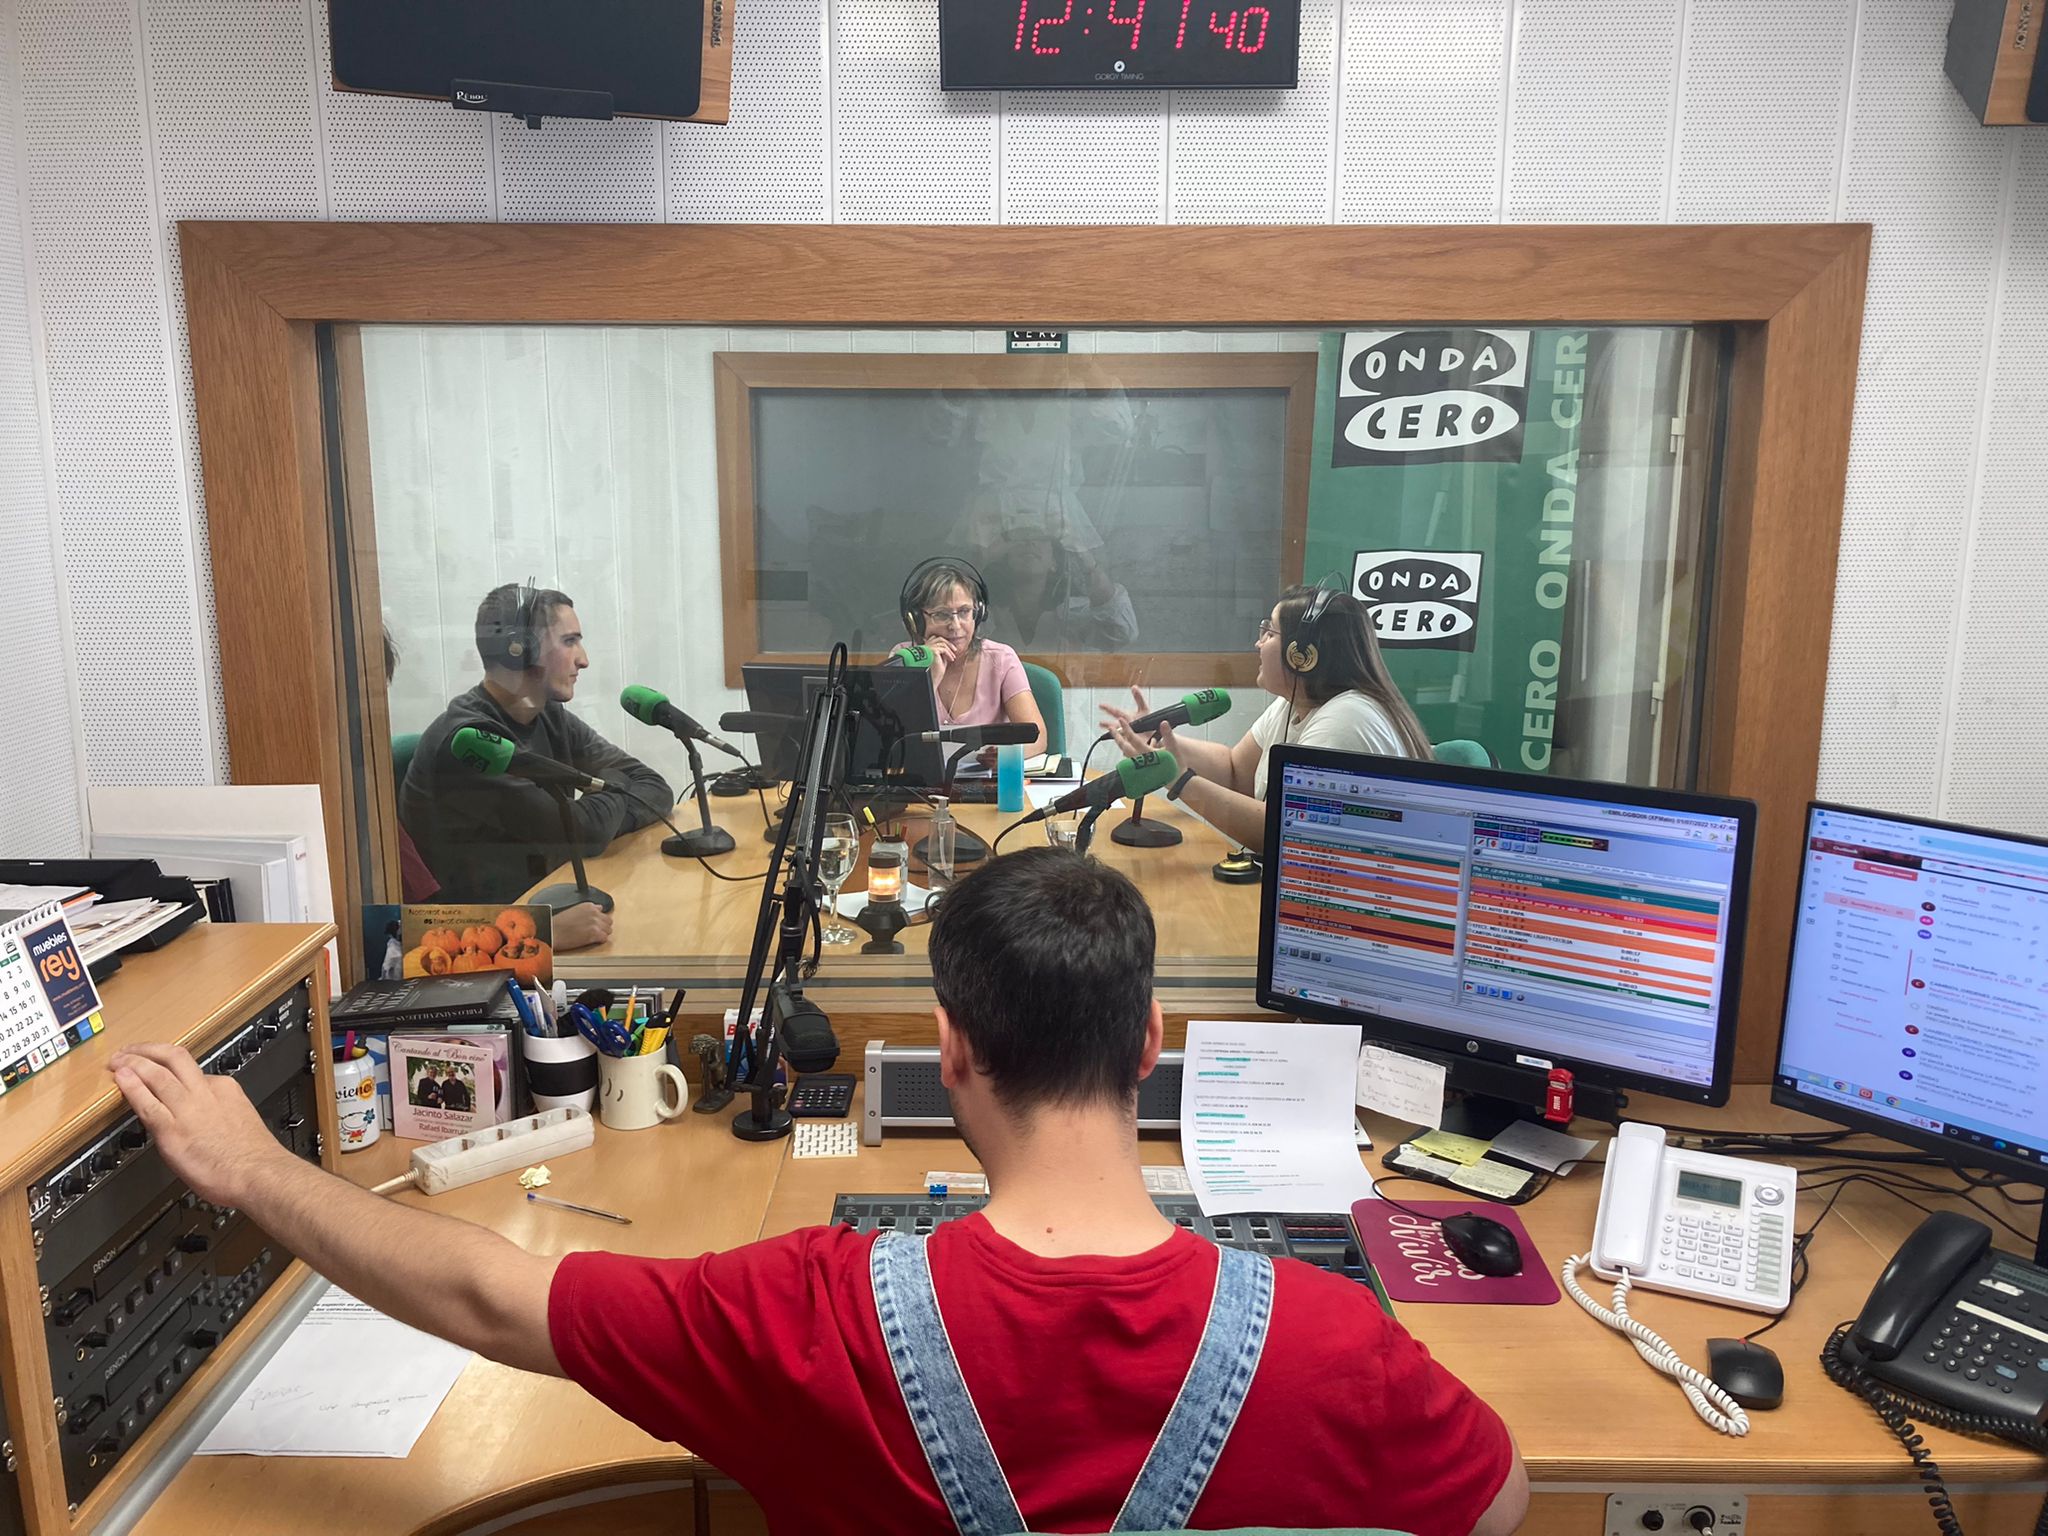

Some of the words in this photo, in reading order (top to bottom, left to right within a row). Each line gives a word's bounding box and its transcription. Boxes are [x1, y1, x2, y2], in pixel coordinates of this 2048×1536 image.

[1210, 7, 1270, 53] 40
[1365, 346, 1498, 380] ONDA
[1367, 404, 1495, 440] CERO
[1536, 448, 1580, 610] ONDA
[1368, 571, 1460, 592] ONDA
[1372, 609, 1457, 633] CERO
[1521, 639, 1561, 772] CERO
[33, 932, 67, 956] muebles
[40, 946, 80, 982] rey
[433, 1049, 441, 1057] al
[413, 1107, 442, 1119] Jacinto
[444, 1111, 473, 1121] Salazar
[29, 1191, 50, 1216] OLLS
[93, 1248, 117, 1274] DENON
[105, 1351, 128, 1379] DENON
